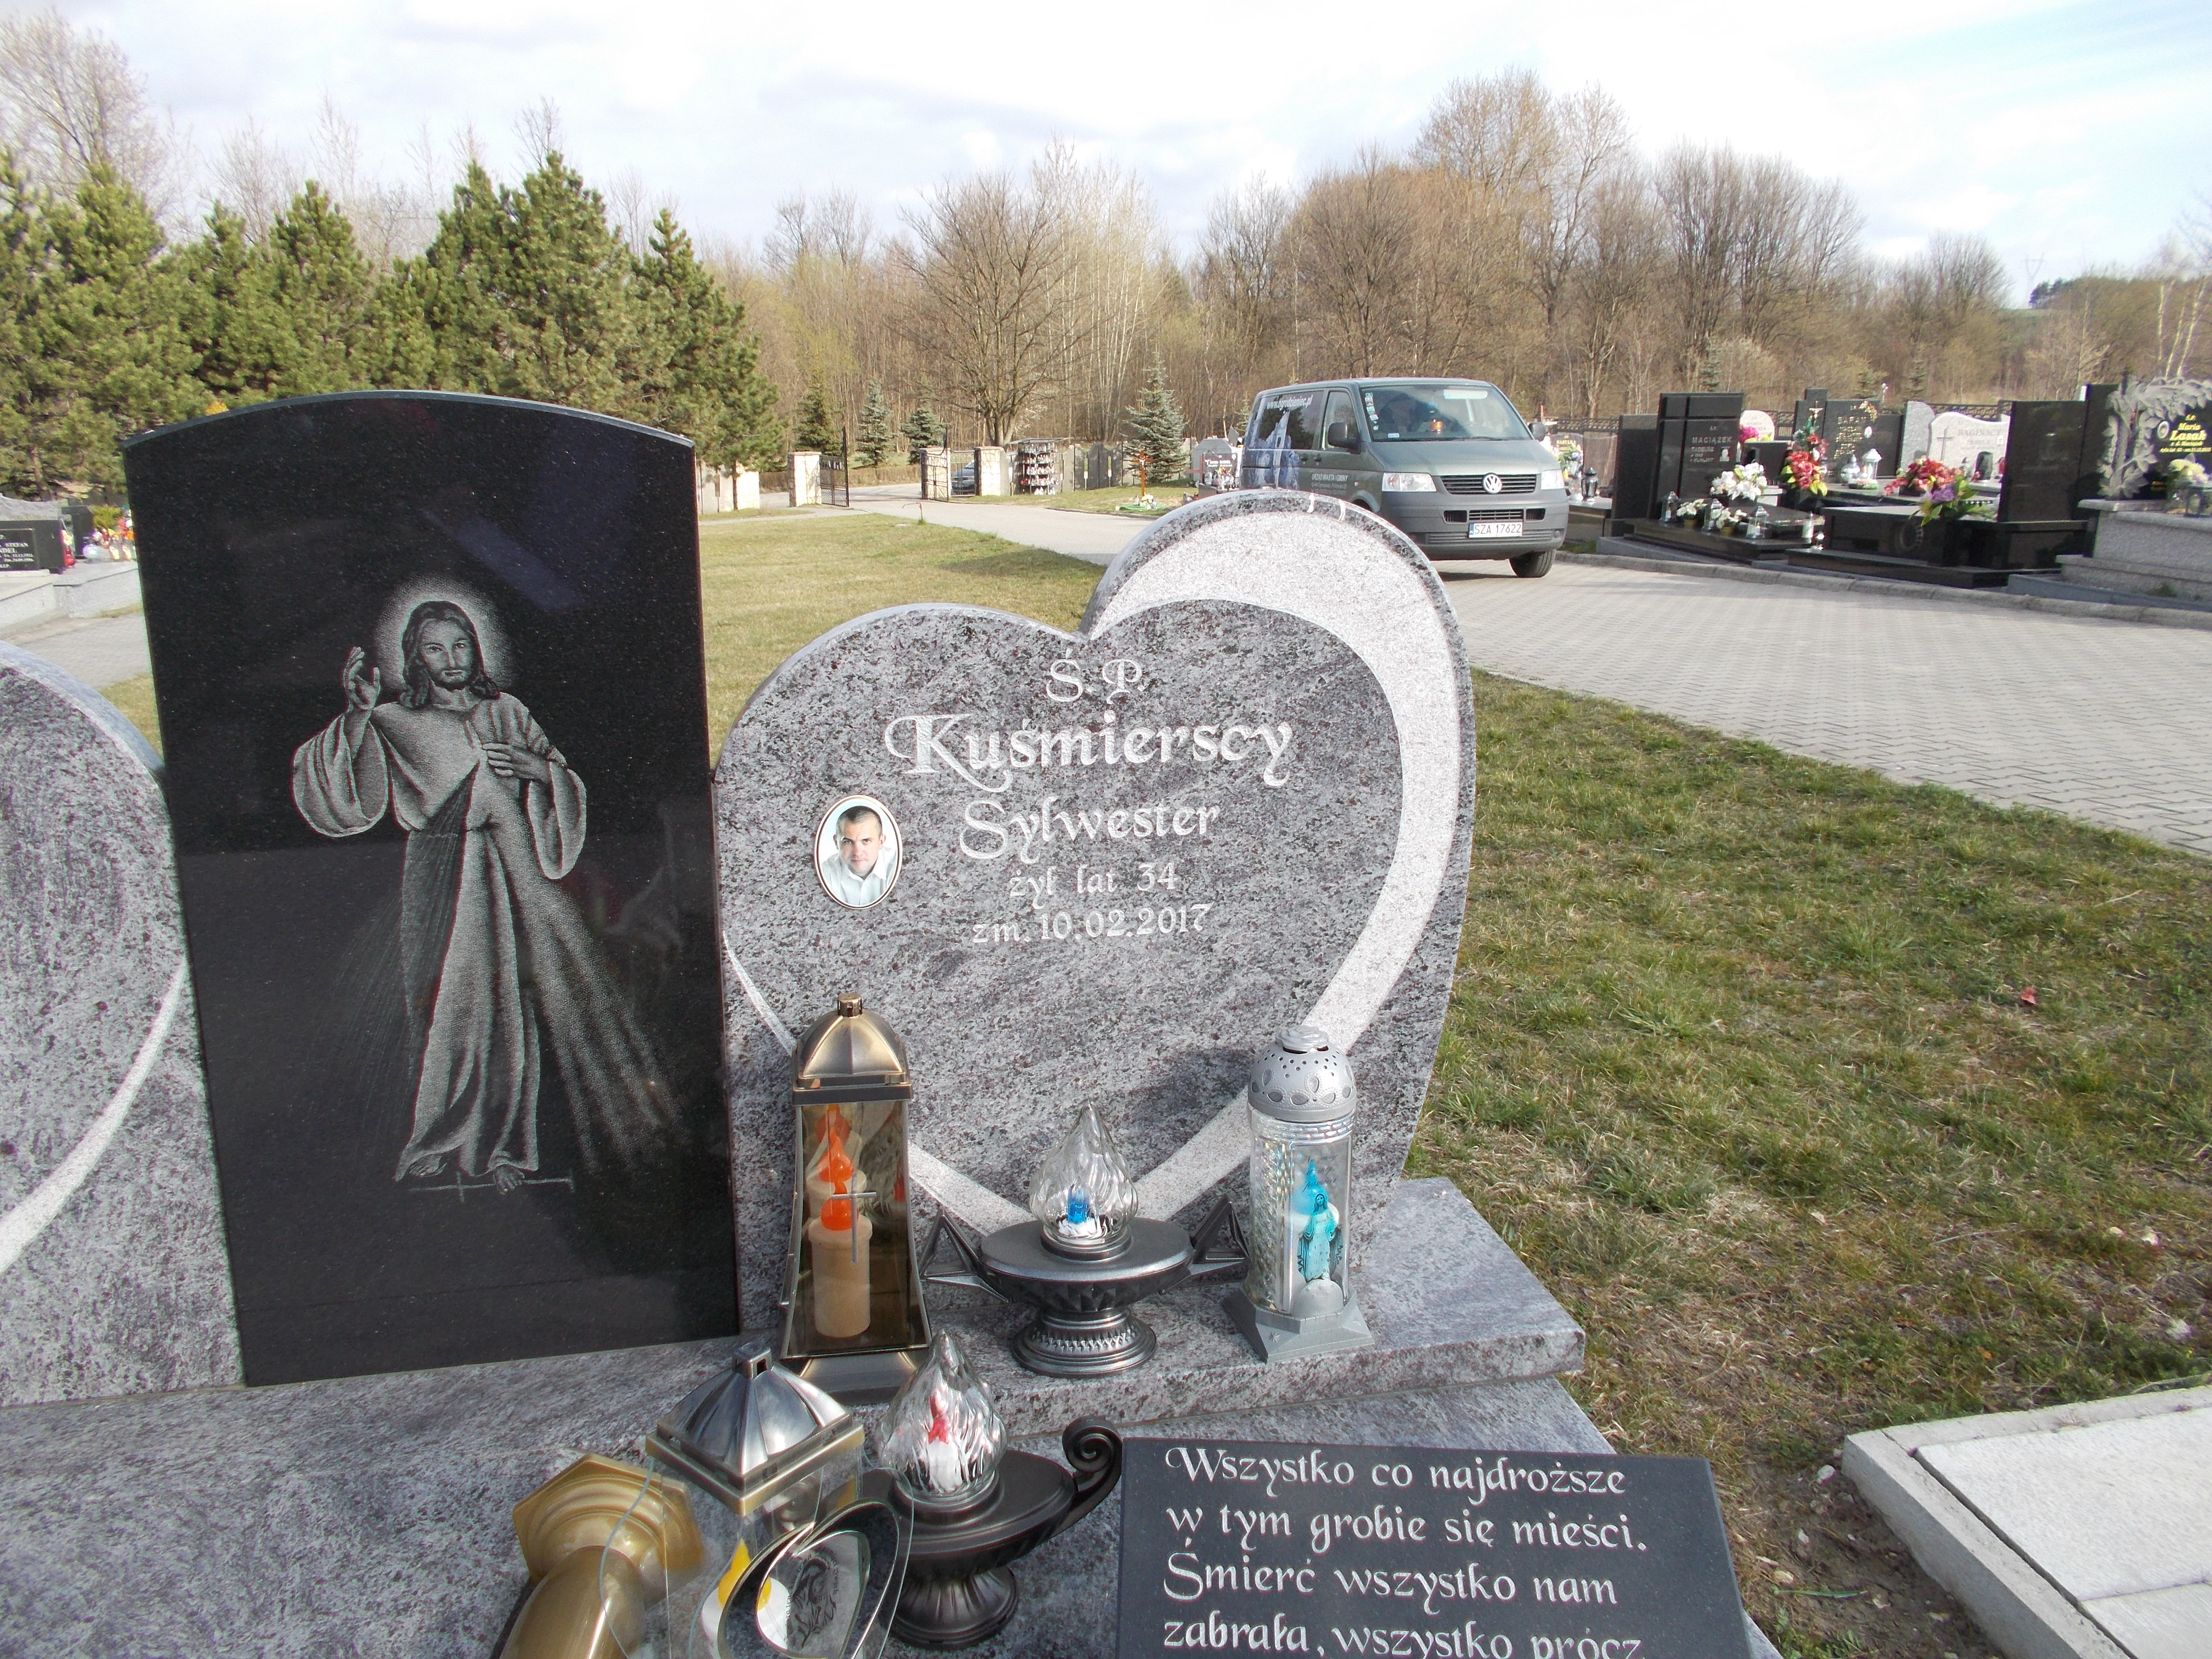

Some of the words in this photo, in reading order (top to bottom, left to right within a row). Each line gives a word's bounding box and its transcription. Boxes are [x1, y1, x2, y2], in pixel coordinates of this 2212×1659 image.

[2170, 430, 2206, 440] Lasak
[1475, 524, 1491, 534] SZA
[1496, 523, 1522, 534] 17622
[884, 710, 1293, 792] Kuśmierscy
[960, 797, 1220, 863] Sylwester
[1077, 865, 1117, 894] lat
[1137, 863, 1178, 891] 34
[1040, 902, 1214, 940] 10.02.2017
[1165, 1447, 1355, 1498] Wszystko
[1371, 1464, 1413, 1487] co
[1430, 1457, 1626, 1505] najdroższe
[1166, 1507, 1203, 1532] w
[1219, 1504, 1292, 1551] tym
[1310, 1504, 1426, 1553] grobie
[1444, 1508, 1495, 1547] się
[1512, 1511, 1647, 1552] mieści.
[1164, 1537, 1316, 1600] Śmierć
[1334, 1563, 1516, 1615] wszystko
[1534, 1576, 1618, 1605] nam
[1164, 1610, 1325, 1658] zabrała,
[1331, 1620, 1513, 1659] wszystko
[1530, 1627, 1645, 1659] prócz
